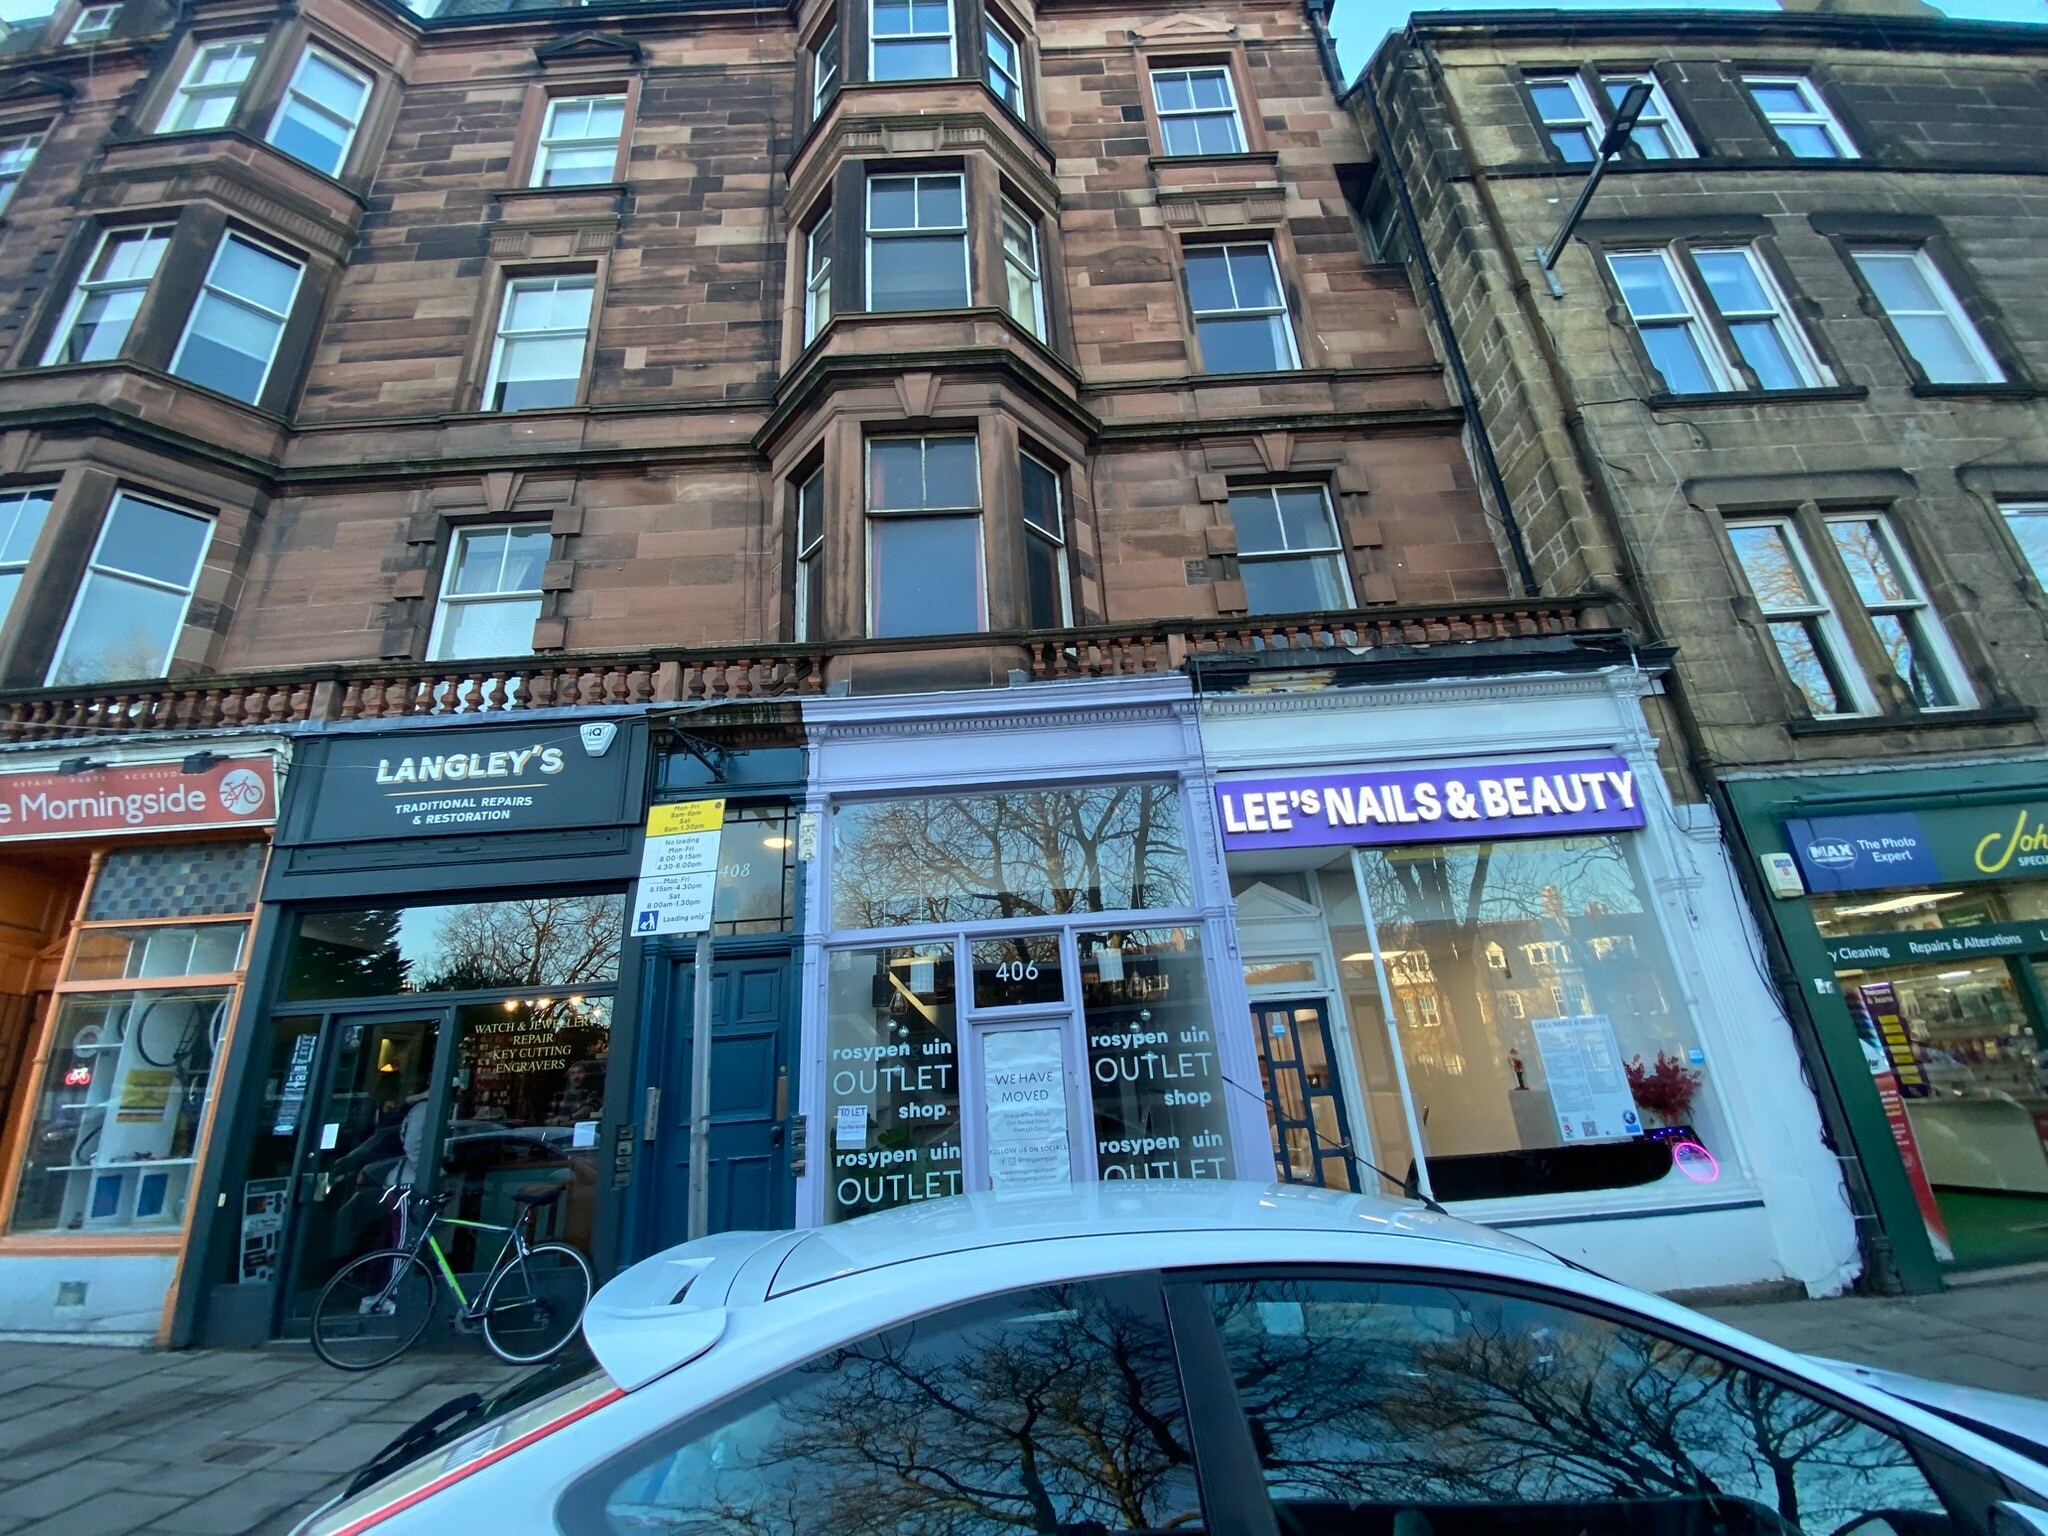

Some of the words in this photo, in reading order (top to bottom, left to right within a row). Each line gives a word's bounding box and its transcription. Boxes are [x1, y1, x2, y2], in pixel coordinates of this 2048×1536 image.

[376, 744, 564, 785] LANGLEY'S
[20, 783, 206, 824] Morningside
[395, 797, 477, 815] TRADITIONAL
[481, 796, 533, 808] REPAIRS
[1325, 781, 1442, 827] NAILS
[1445, 780, 1481, 821] &
[1481, 770, 1636, 819] BEAUTY
[412, 815, 422, 826] &
[426, 809, 511, 825] RESTORATION
[676, 836, 700, 845] loading
[1856, 839, 1881, 851] The
[1882, 836, 1916, 848] Photo
[1810, 844, 1854, 858] MAX
[1873, 850, 1913, 864] Expert
[718, 863, 750, 878] 408
[663, 915, 689, 924] Loading
[690, 913, 705, 922] only
[1840, 945, 1890, 960] Cleaning
[1909, 938, 1951, 955] Repairs
[1953, 938, 1963, 949] &
[1964, 933, 2023, 949] Alterations
[996, 960, 1039, 982] 406
[474, 1021, 515, 1034] WATCH
[517, 1021, 527, 1032] &
[513, 1033, 554, 1046] REPAIR
[1091, 1029, 1169, 1051] rosypen
[1180, 1025, 1211, 1044] uin
[493, 1048, 517, 1060] KEY
[519, 1045, 572, 1059] CUTTING
[832, 1041, 911, 1062] rosypen
[922, 1037, 952, 1056] uin
[495, 1058, 566, 1074] ENGRAVERS
[1095, 1052, 1213, 1083] OUTLET
[833, 1063, 953, 1096] OUTLET
[995, 1073, 1016, 1085] WE
[1019, 1071, 1053, 1084] HAVE
[1001, 1089, 1049, 1103] MOVED
[1164, 1087, 1212, 1107] shop
[840, 1108, 851, 1117] TO
[851, 1107, 867, 1117] LET
[898, 1101, 947, 1121] shop
[1098, 1136, 1180, 1156] rosypen
[1192, 1129, 1224, 1149] uin
[836, 1148, 918, 1169] rosypen
[930, 1141, 961, 1161] uin
[837, 1170, 962, 1206] OUTLET
